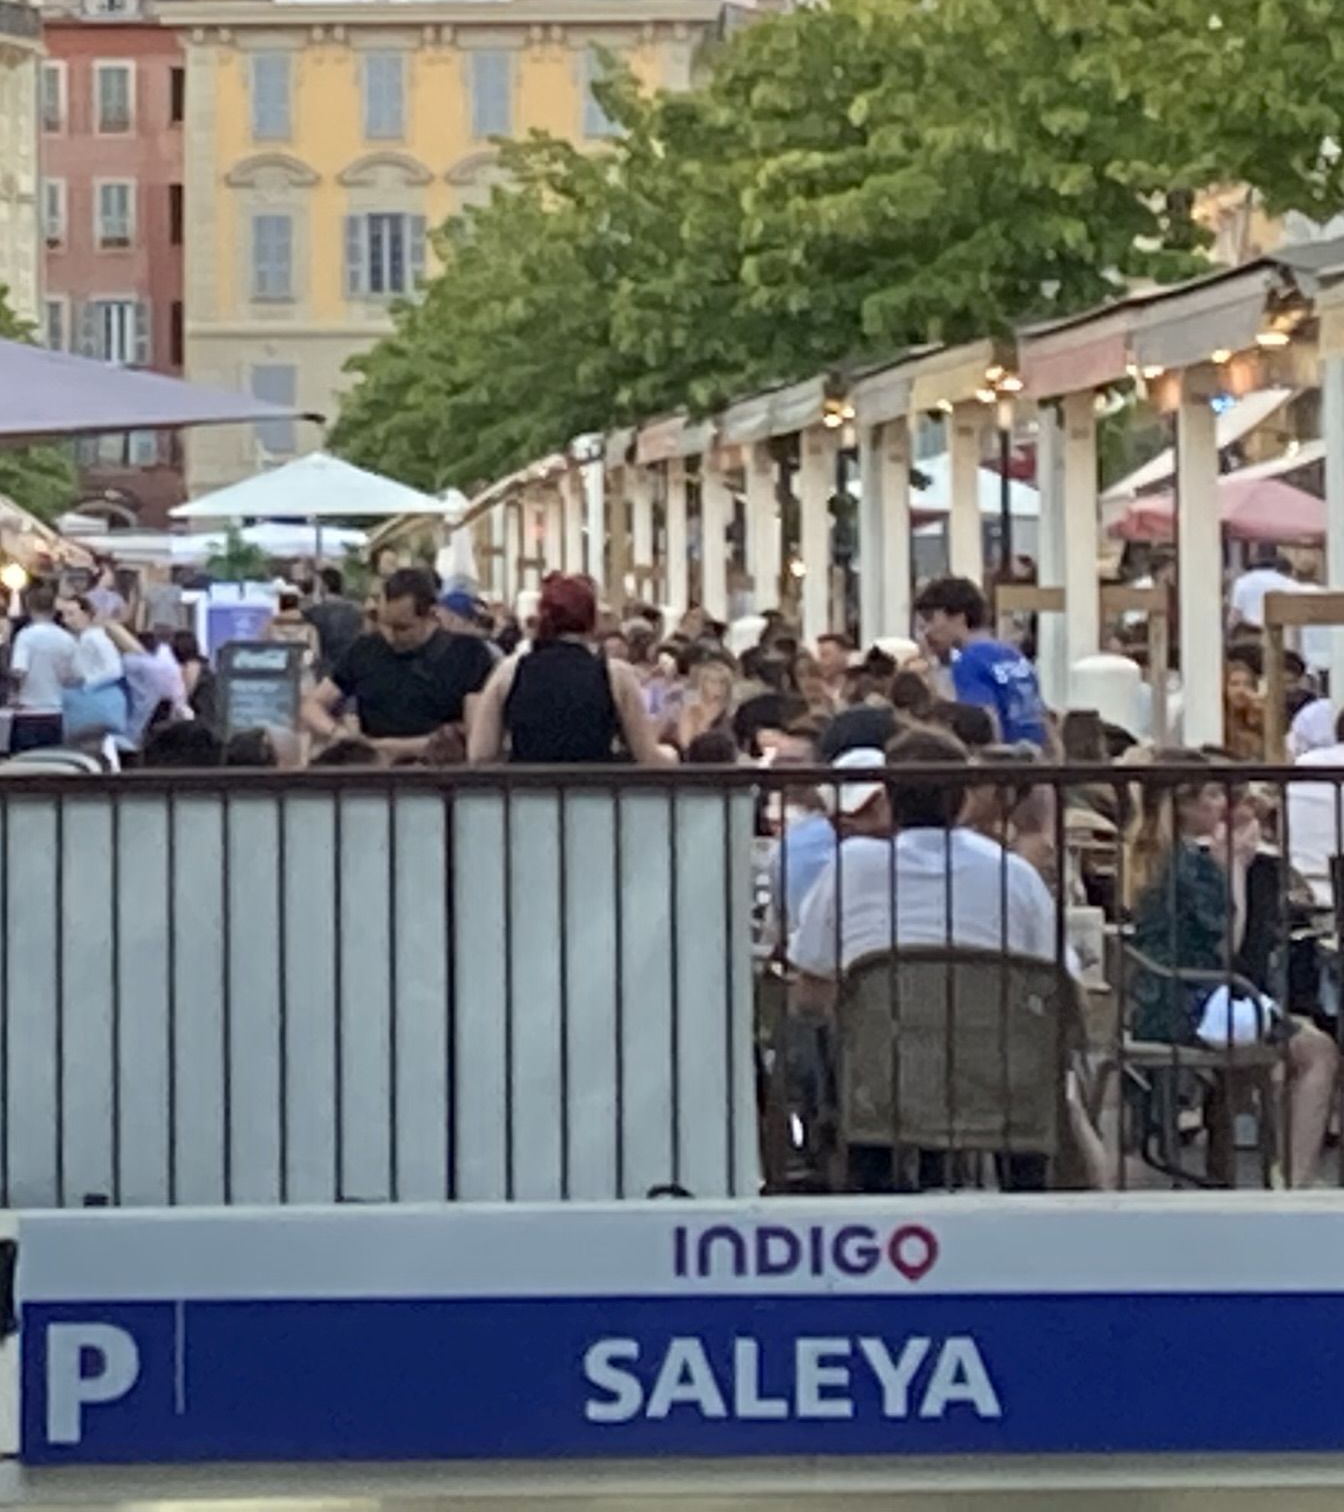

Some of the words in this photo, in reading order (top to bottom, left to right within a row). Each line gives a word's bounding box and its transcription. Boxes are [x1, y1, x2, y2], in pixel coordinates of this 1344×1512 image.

[672, 1222, 940, 1284] INDIGO
[46, 1321, 141, 1445] P
[585, 1338, 1000, 1420] SALEYA
